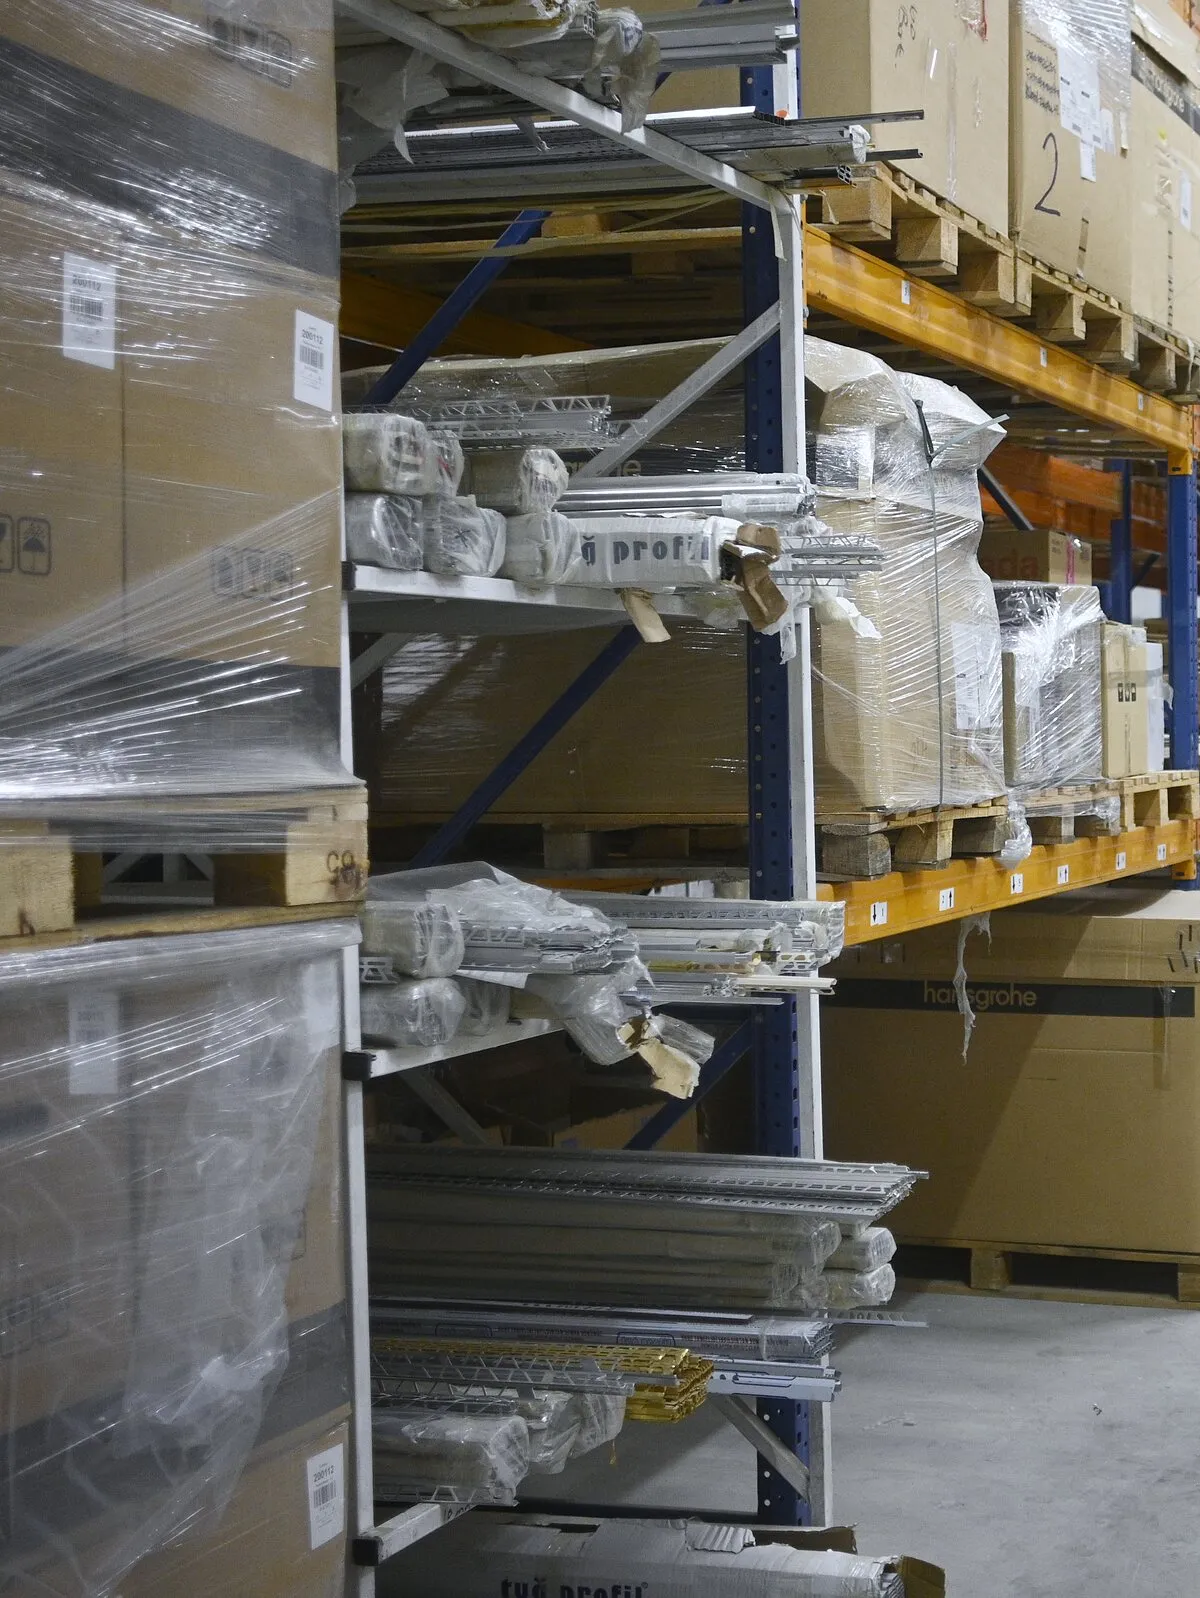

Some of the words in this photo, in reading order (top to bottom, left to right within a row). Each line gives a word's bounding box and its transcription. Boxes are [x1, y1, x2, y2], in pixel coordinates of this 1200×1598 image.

[1034, 132, 1061, 217] 2
[302, 329, 325, 345] 200112
[612, 535, 710, 565] profil
[313, 1464, 335, 1483] 200112
